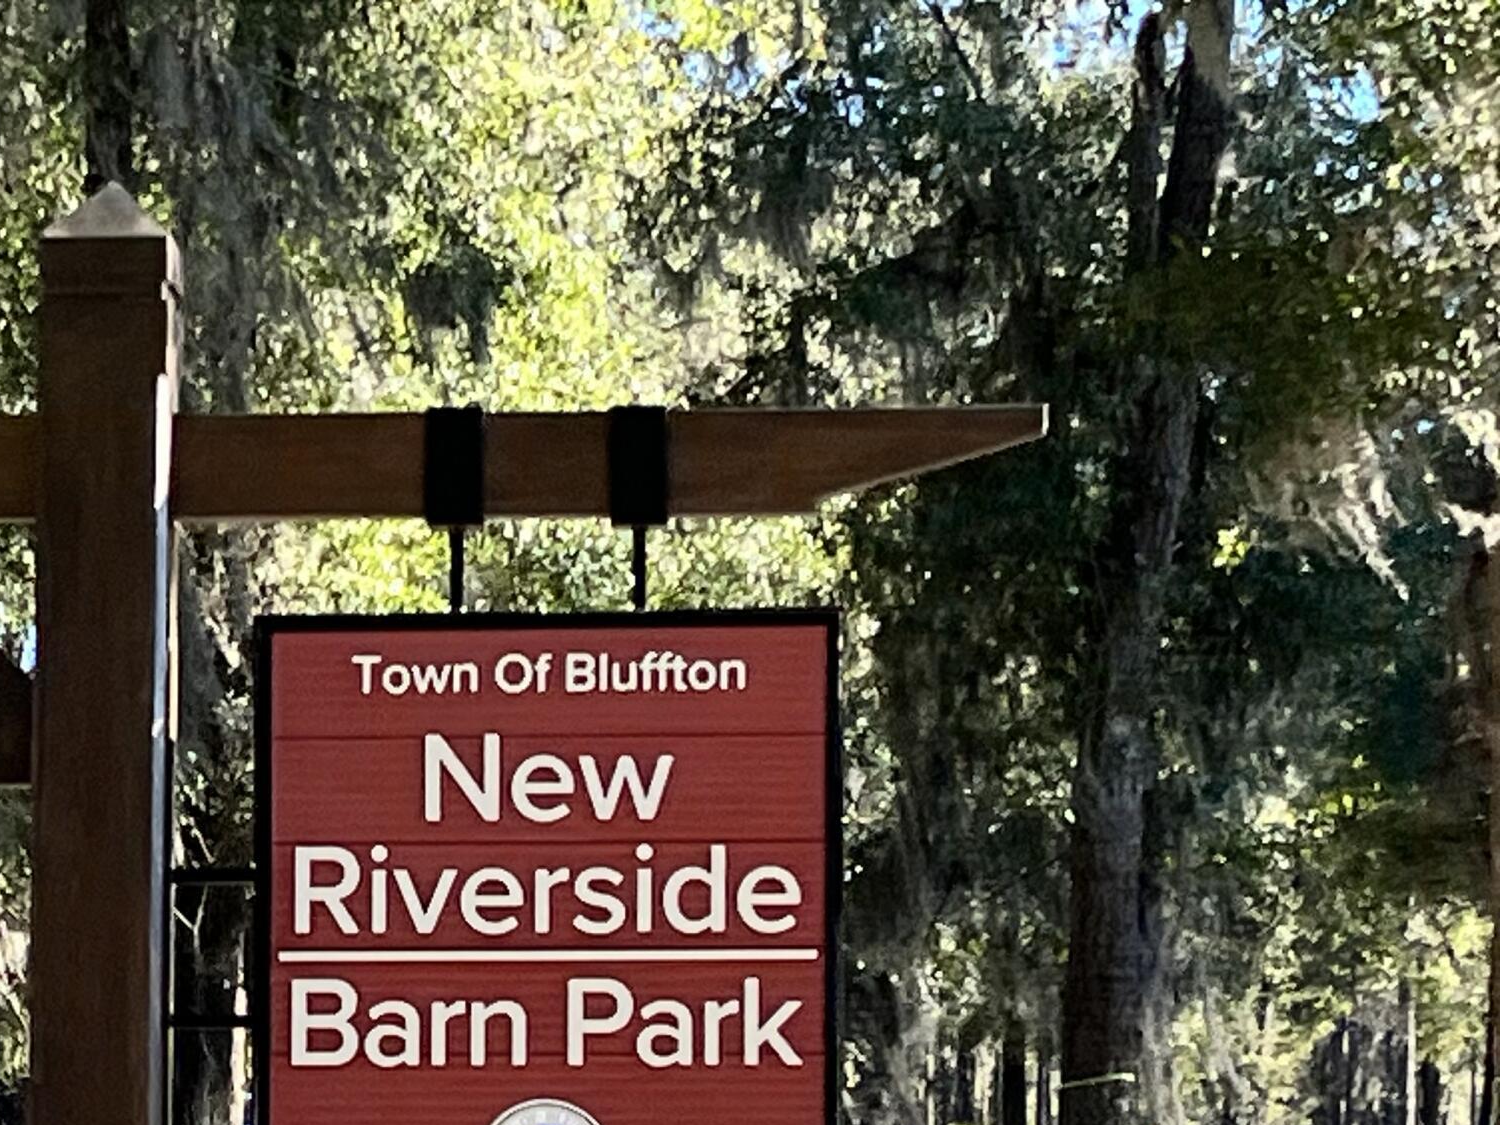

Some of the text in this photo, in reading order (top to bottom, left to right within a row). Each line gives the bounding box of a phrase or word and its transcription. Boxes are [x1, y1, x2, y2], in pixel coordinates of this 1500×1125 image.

[352, 652, 747, 695] Town Of Bluffton
[423, 732, 674, 823] New
[293, 844, 802, 935] Riverside
[290, 977, 803, 1067] Barn Park
